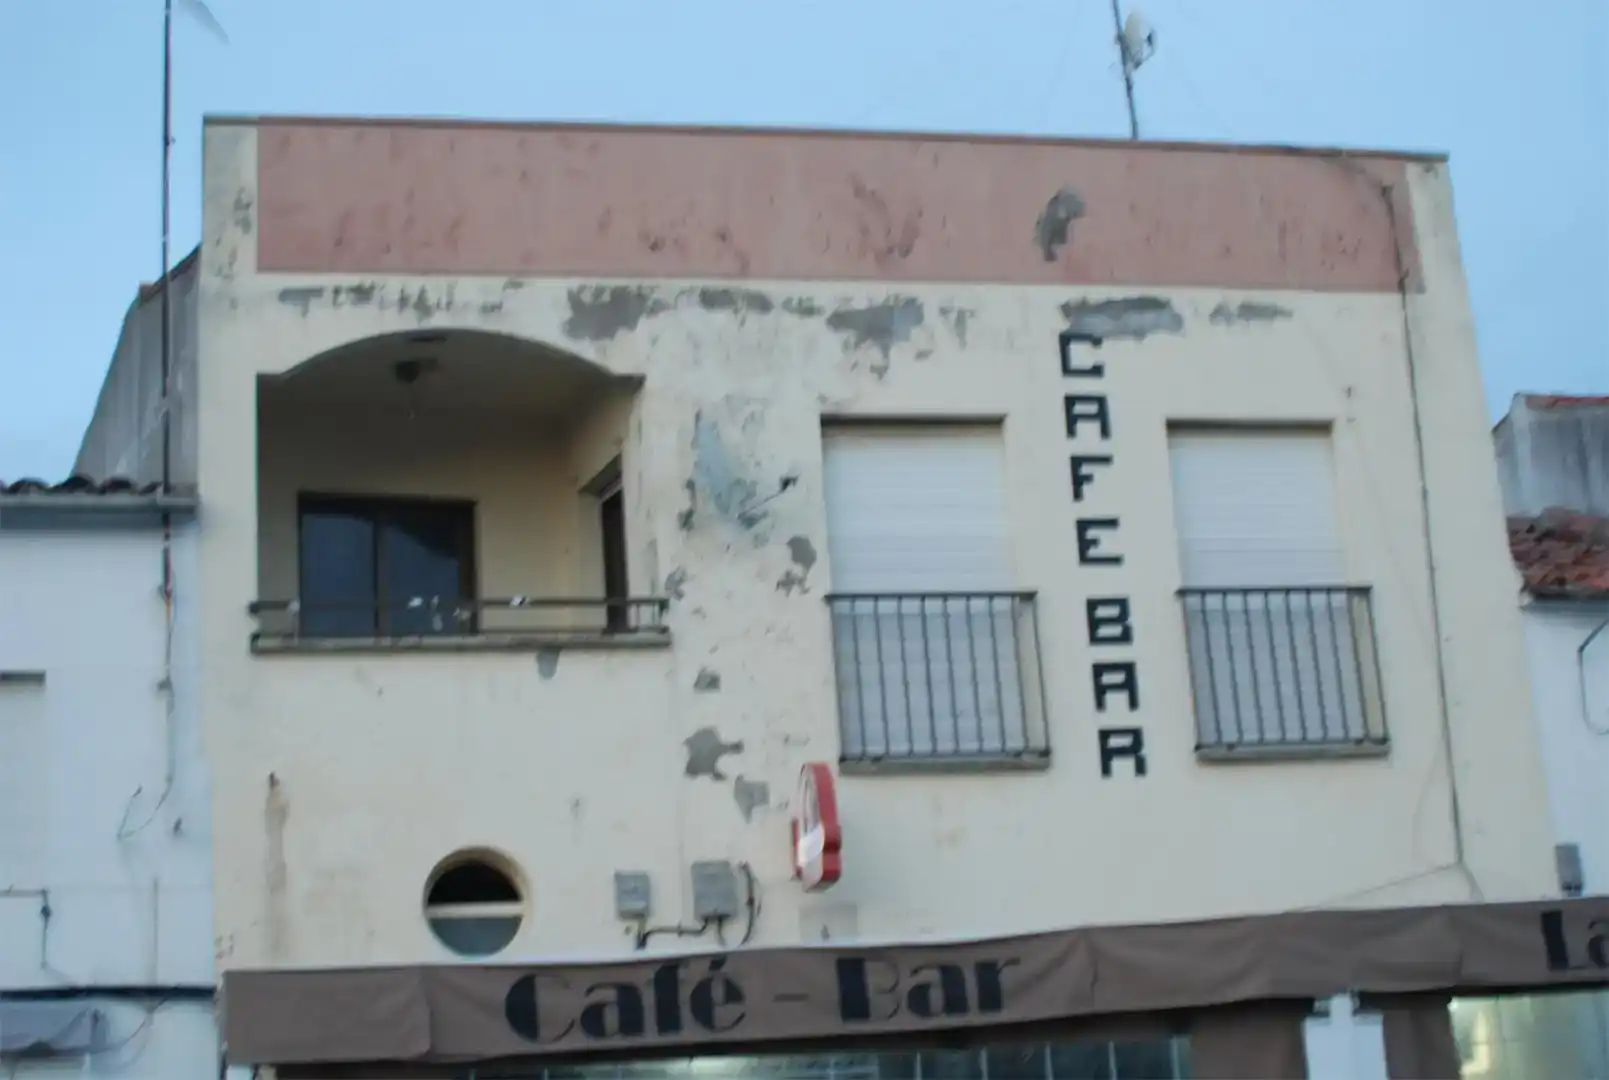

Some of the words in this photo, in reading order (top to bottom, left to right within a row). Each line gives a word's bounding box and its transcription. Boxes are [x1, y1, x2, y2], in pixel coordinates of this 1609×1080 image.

[1059, 333, 1124, 565] CAFE
[1086, 598, 1147, 777] BAR
[504, 956, 746, 1043] Café
[835, 956, 1021, 1022] Bar
